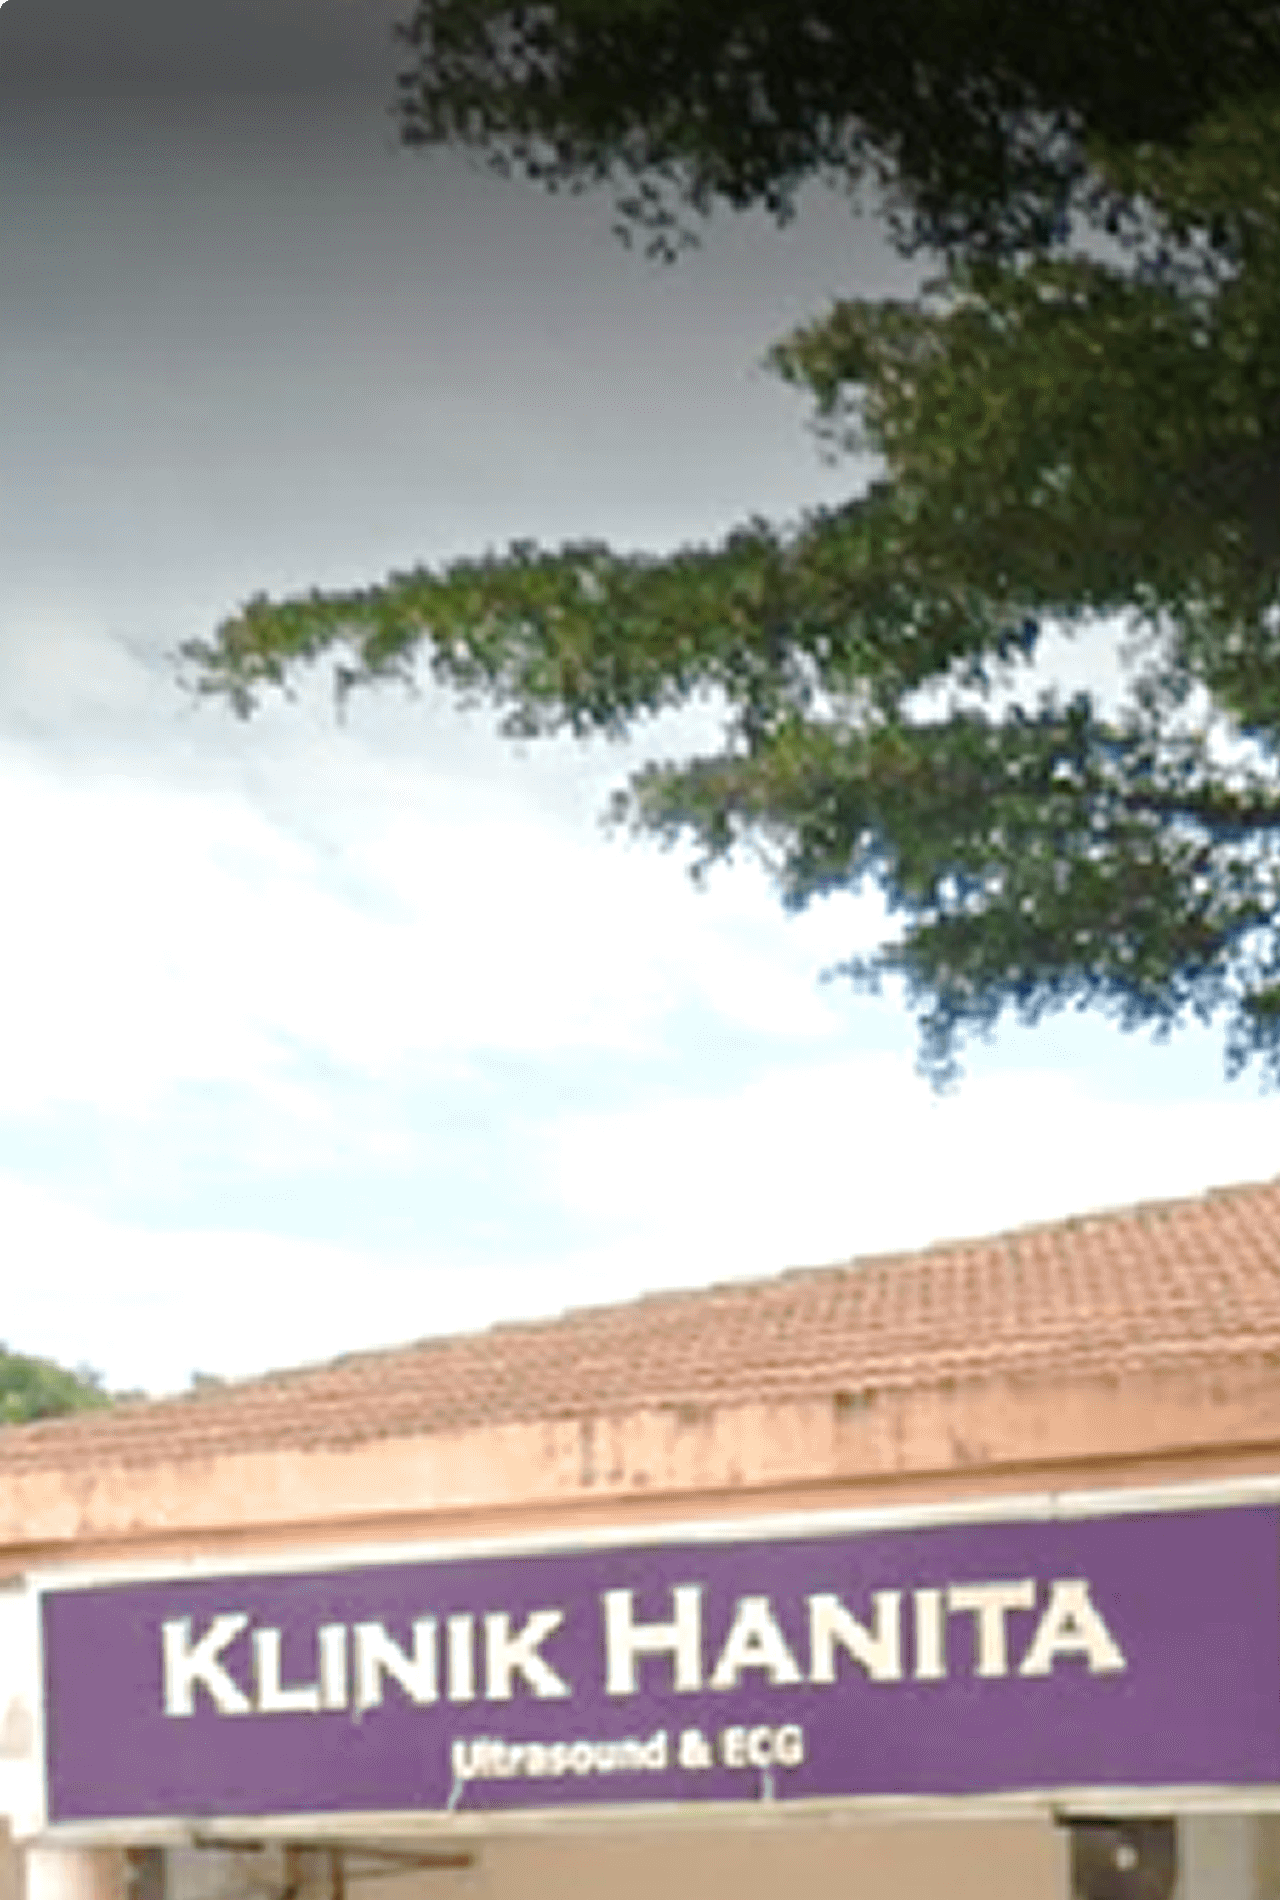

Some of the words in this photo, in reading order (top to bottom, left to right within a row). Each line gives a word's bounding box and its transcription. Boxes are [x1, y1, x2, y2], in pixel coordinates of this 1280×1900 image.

[162, 1611, 571, 1717] KLINIK
[602, 1579, 1127, 1695] HANITA
[452, 1729, 669, 1779] Ultrasound
[679, 1729, 714, 1769] &
[723, 1724, 805, 1768] ECG
